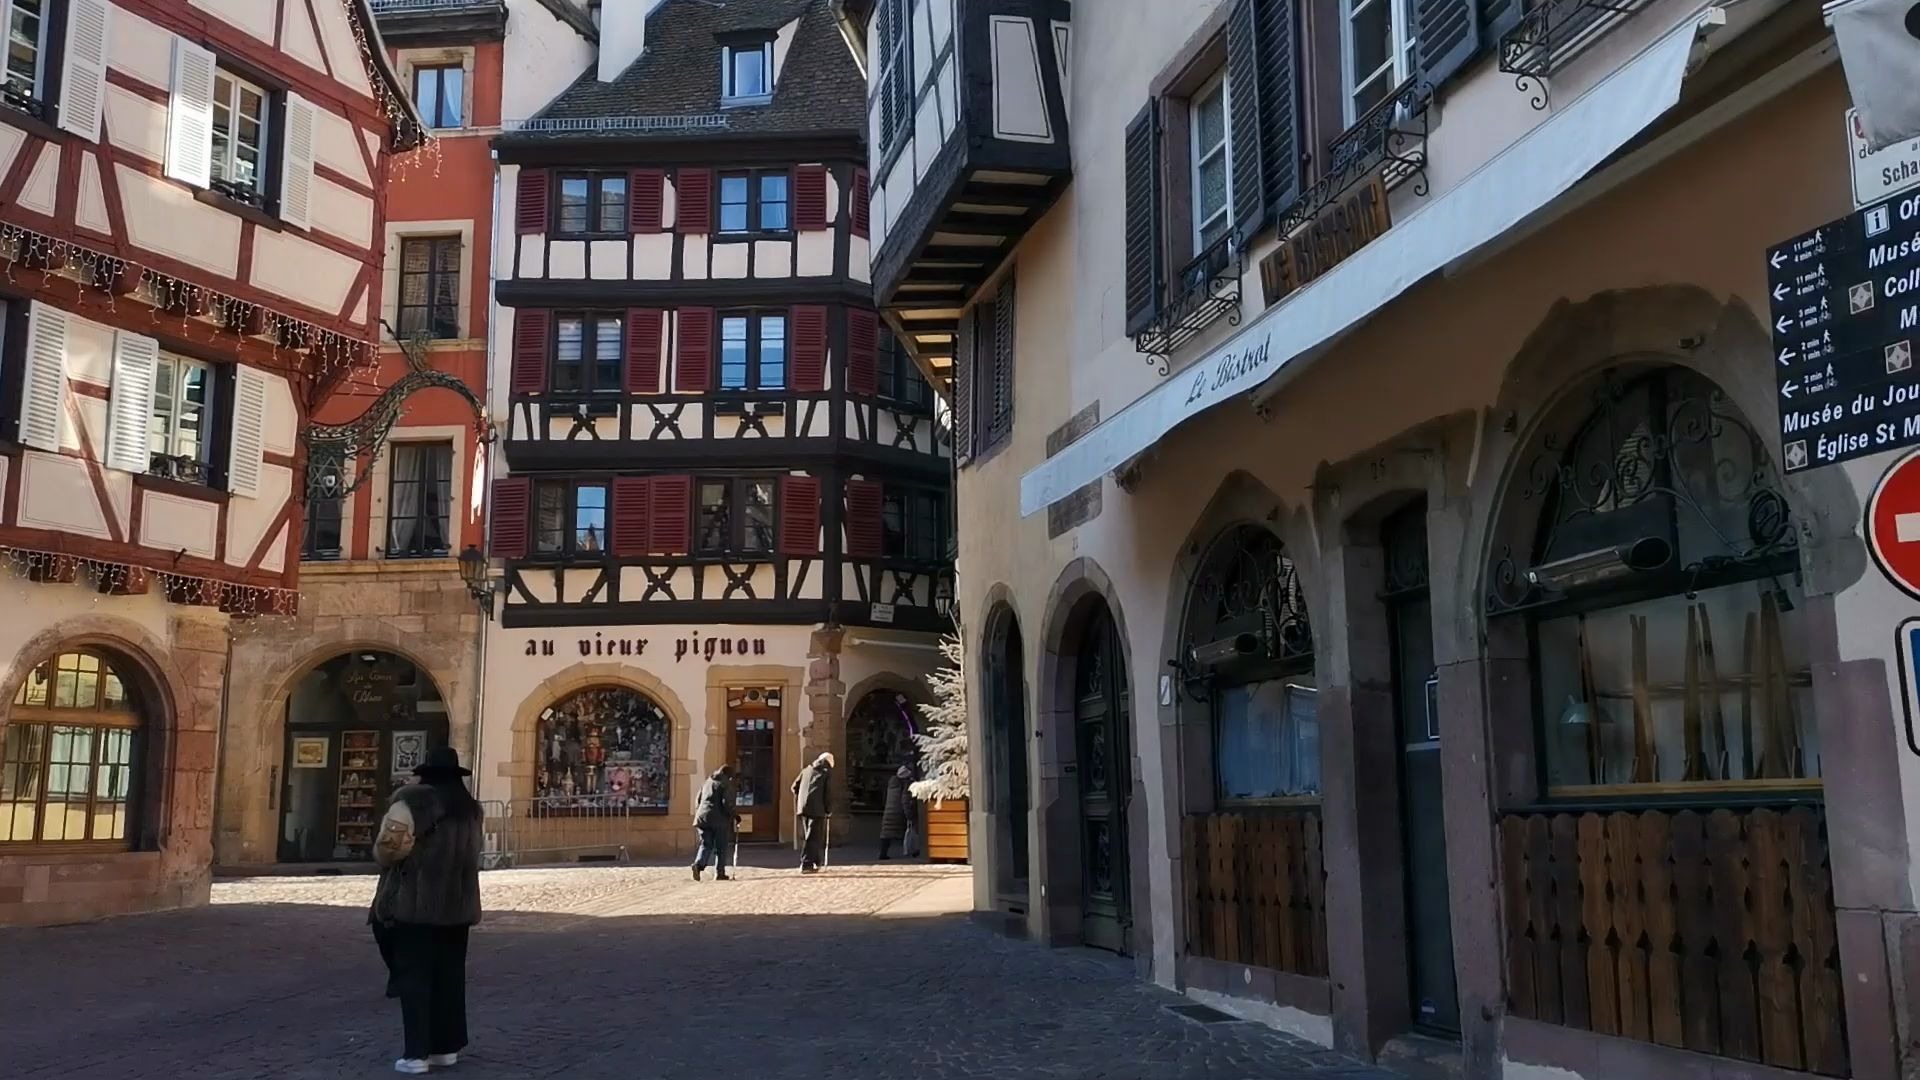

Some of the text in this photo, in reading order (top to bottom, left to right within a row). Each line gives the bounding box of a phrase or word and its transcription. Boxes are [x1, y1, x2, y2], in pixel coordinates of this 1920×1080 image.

[1802, 238, 1815, 249] min
[1799, 251, 1812, 261] min
[1804, 272, 1817, 282] min
[1884, 267, 1920, 297] Coll
[1802, 284, 1815, 294] min
[1804, 305, 1817, 316] min
[1804, 317, 1818, 327] min
[1806, 338, 1820, 349] min
[1807, 350, 1821, 360] min
[1185, 332, 1272, 407] Le Bistrot
[1810, 372, 1823, 382] min
[1810, 384, 1824, 393] min
[1783, 383, 1920, 434] Musée du Jou
[1817, 433, 1869, 461] Église
[1875, 423, 1896, 444] St
[525, 638, 554, 657] au
[675, 629, 765, 663] pignon
